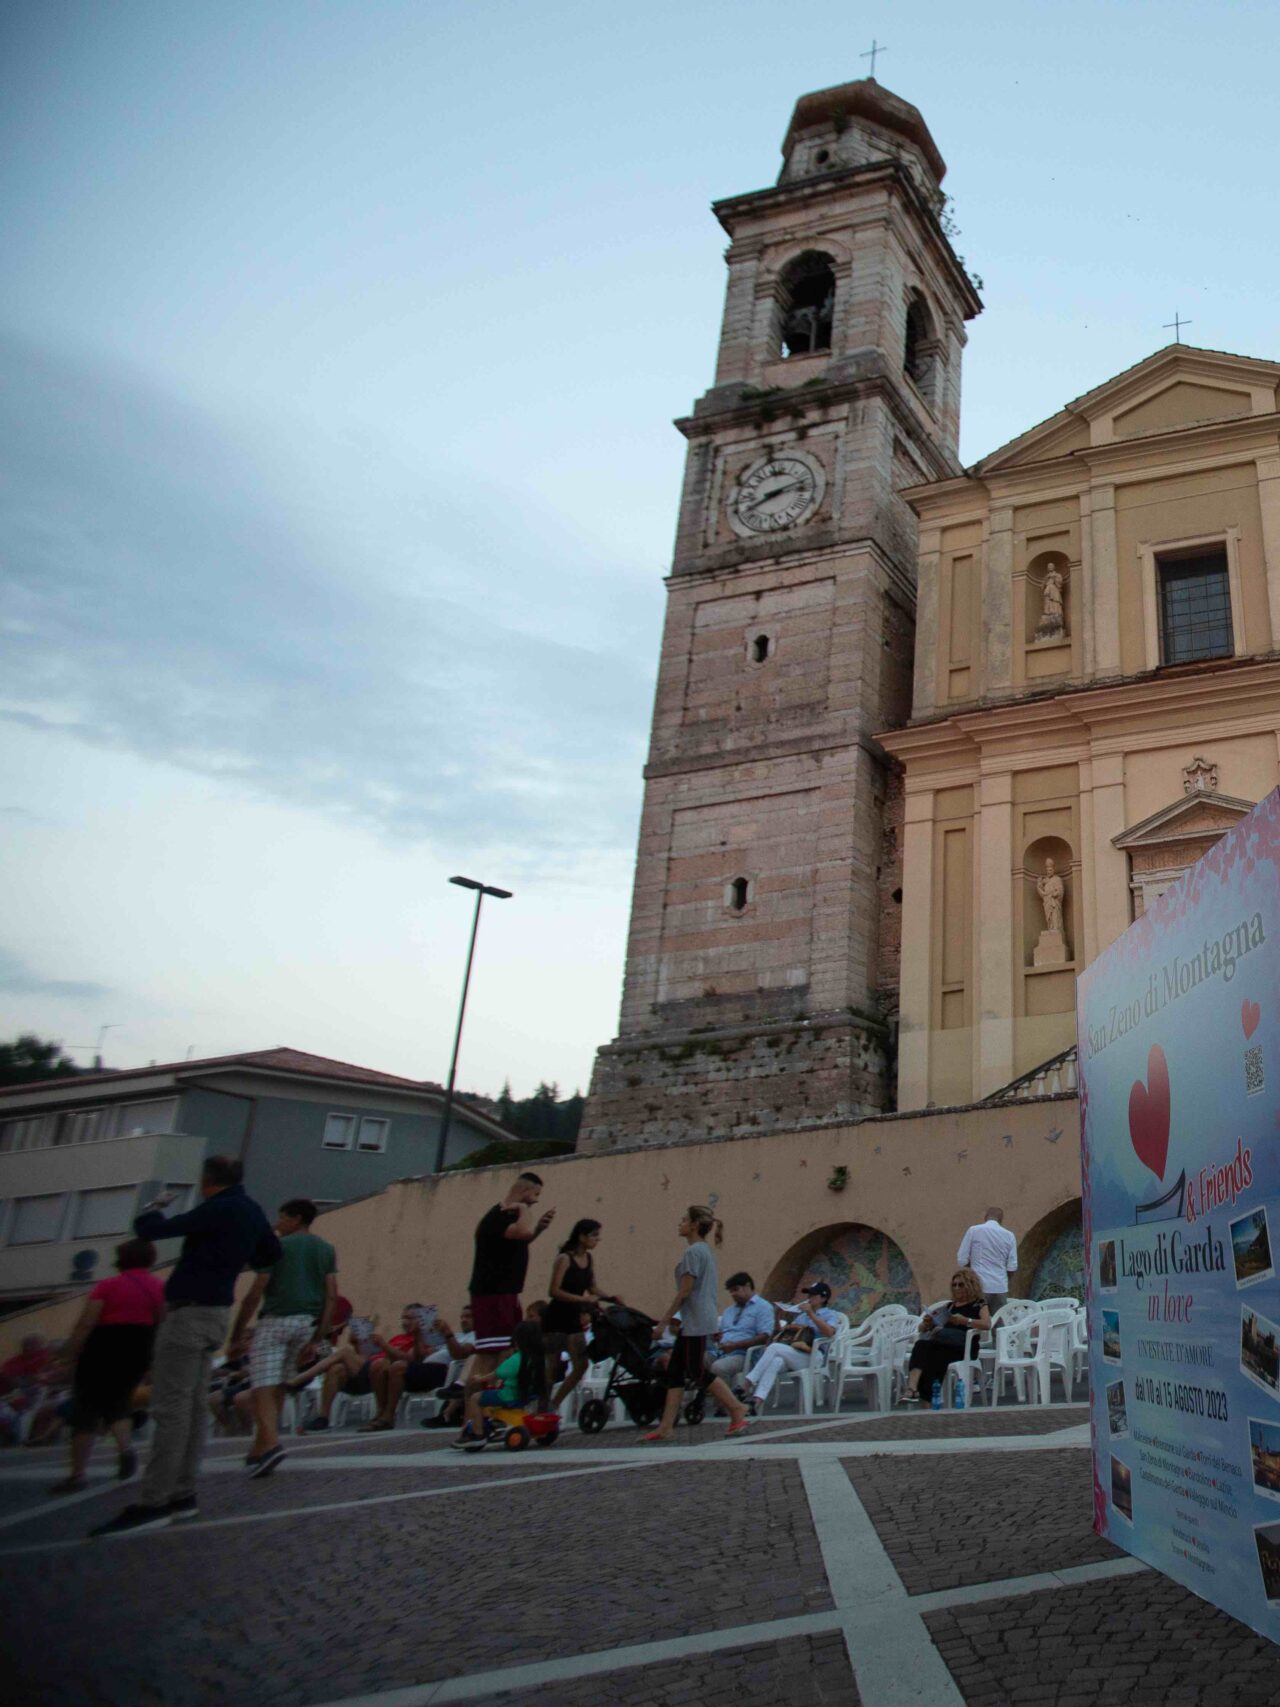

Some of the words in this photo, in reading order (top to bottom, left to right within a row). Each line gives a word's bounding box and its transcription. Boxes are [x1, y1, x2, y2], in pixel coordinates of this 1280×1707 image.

[1087, 1024, 1106, 1060] San
[1109, 1000, 1141, 1044] Zeno
[1144, 973, 1159, 1018] di
[1162, 912, 1266, 1006] Montagna
[1186, 1181, 1196, 1223] &
[1199, 1136, 1253, 1216] Friends
[1121, 1239, 1152, 1290] Lago
[1154, 1232, 1168, 1276] di
[1170, 1225, 1226, 1274] Garda
[1148, 1283, 1160, 1321] in
[1164, 1279, 1193, 1323] love
[1137, 1339, 1174, 1361] UN'ESTATE
[1176, 1343, 1214, 1367] D'AMORE
[1136, 1376, 1145, 1401] dal
[1156, 1380, 1163, 1406] al
[1163, 1381, 1172, 1408] 15
[1174, 1384, 1204, 1416] AGOSTO
[1206, 1389, 1228, 1422] 2023
